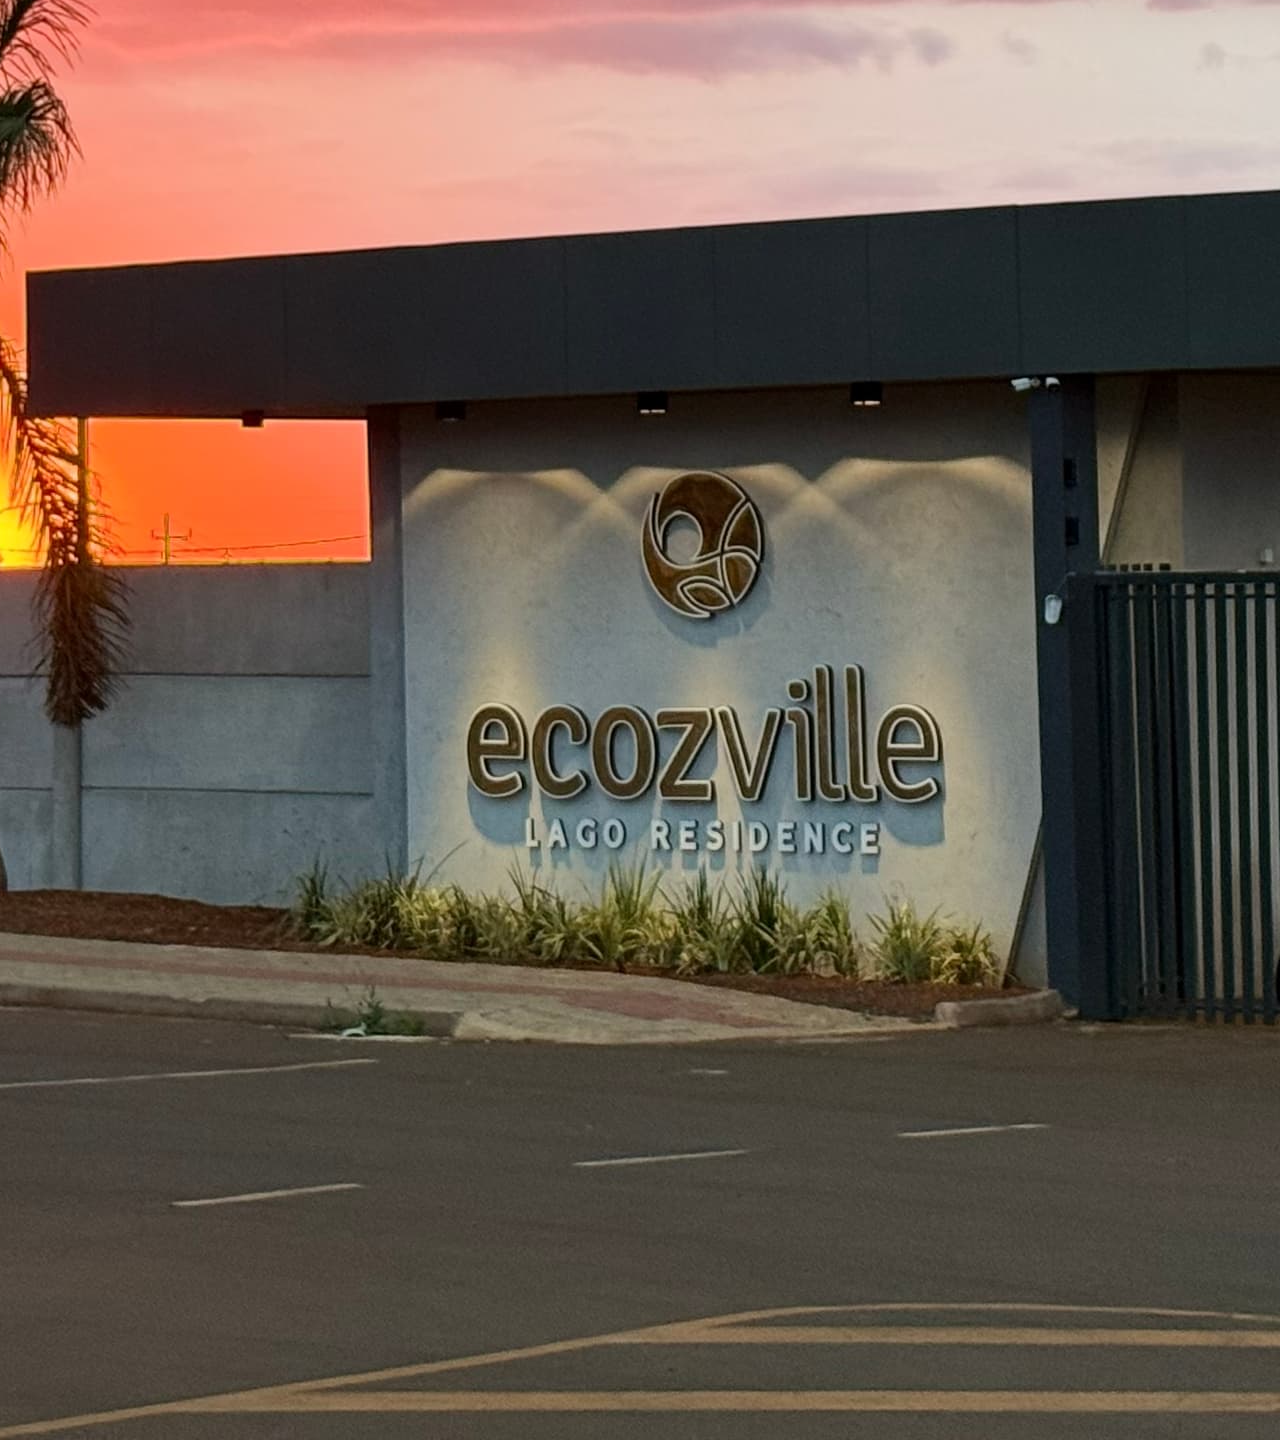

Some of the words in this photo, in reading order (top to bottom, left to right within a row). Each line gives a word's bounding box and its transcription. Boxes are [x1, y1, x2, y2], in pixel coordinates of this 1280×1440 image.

[466, 663, 943, 804] ecozville
[524, 817, 627, 850] LAGO
[650, 818, 882, 855] RESIDENCE
